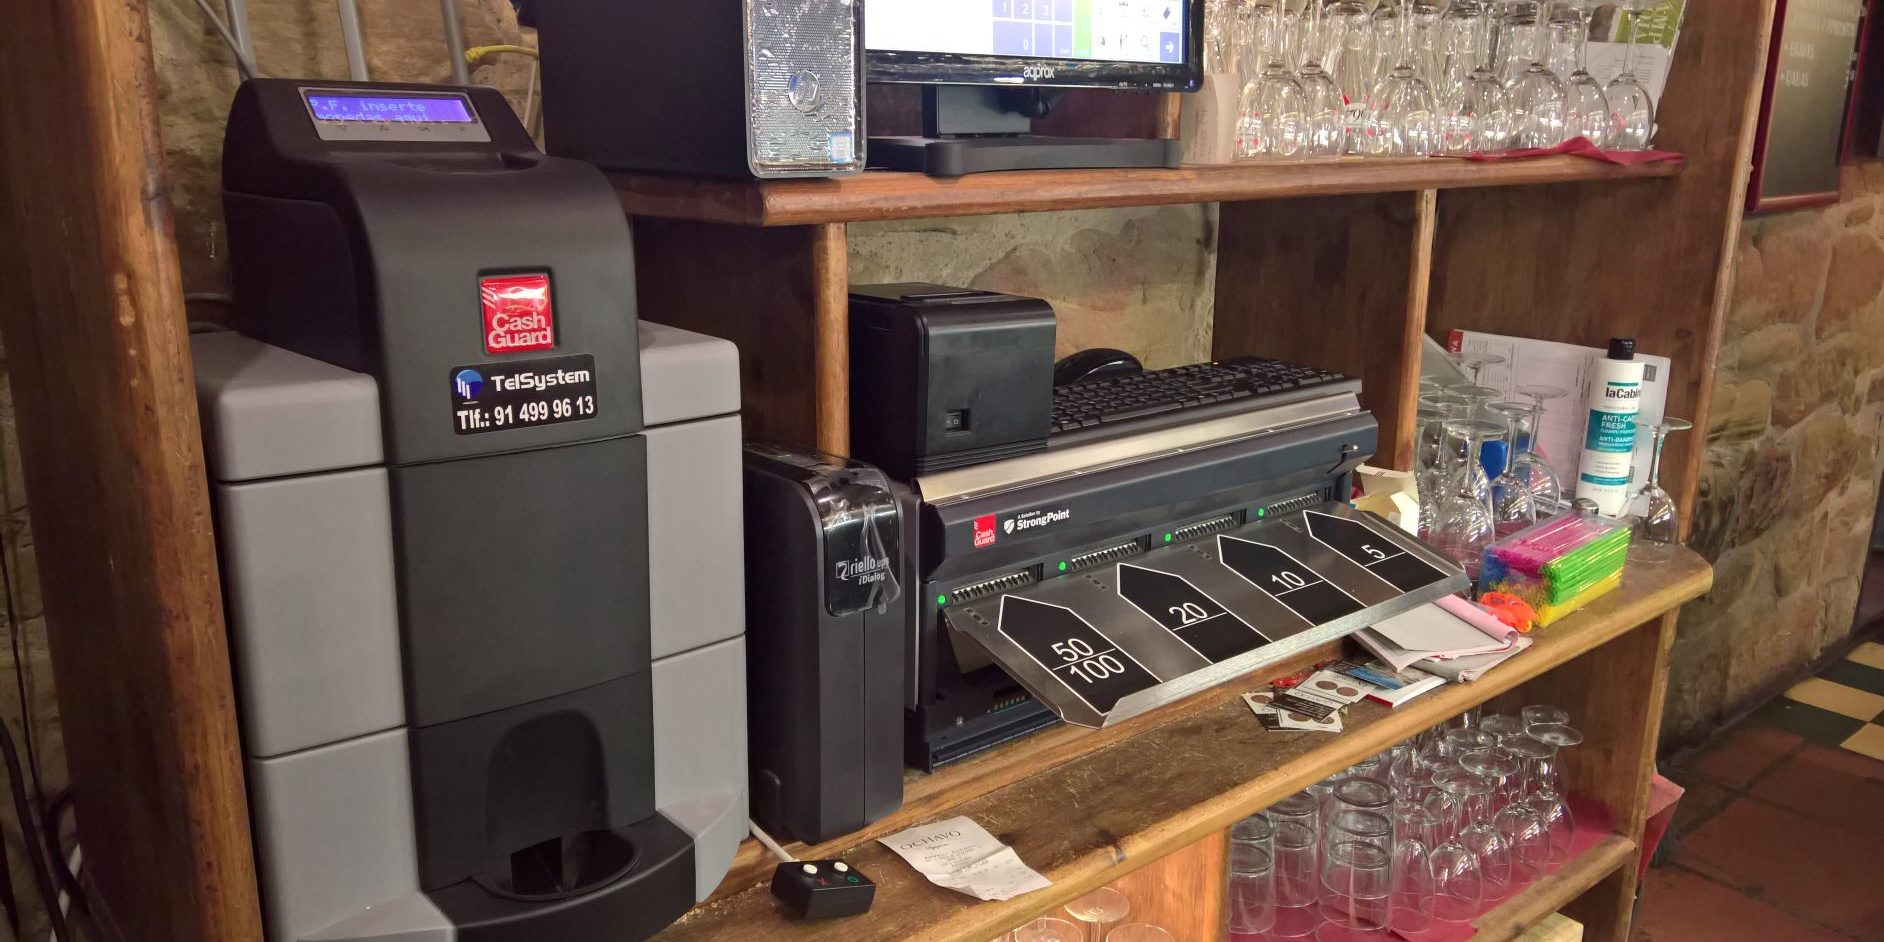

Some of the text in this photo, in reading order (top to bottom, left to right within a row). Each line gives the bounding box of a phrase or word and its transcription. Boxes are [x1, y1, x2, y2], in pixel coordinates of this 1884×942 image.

[492, 311, 546, 332] Cash
[488, 326, 552, 349] Guard
[491, 369, 590, 392] TelSystem
[457, 395, 594, 430] Tlf.: 91 499 96 13
[1601, 421, 1627, 429] FRESH
[1017, 508, 1070, 531] StrongPoint
[974, 534, 995, 547] Guard
[975, 528, 994, 539] Cash
[1361, 544, 1386, 559] 5
[850, 555, 876, 575] riello
[858, 572, 886, 586] iDialog
[1271, 571, 1306, 590] 10
[1168, 602, 1208, 625] 20
[1050, 638, 1094, 662] 50
[1069, 654, 1125, 684] 100
[900, 830, 961, 850] OCHAVO
